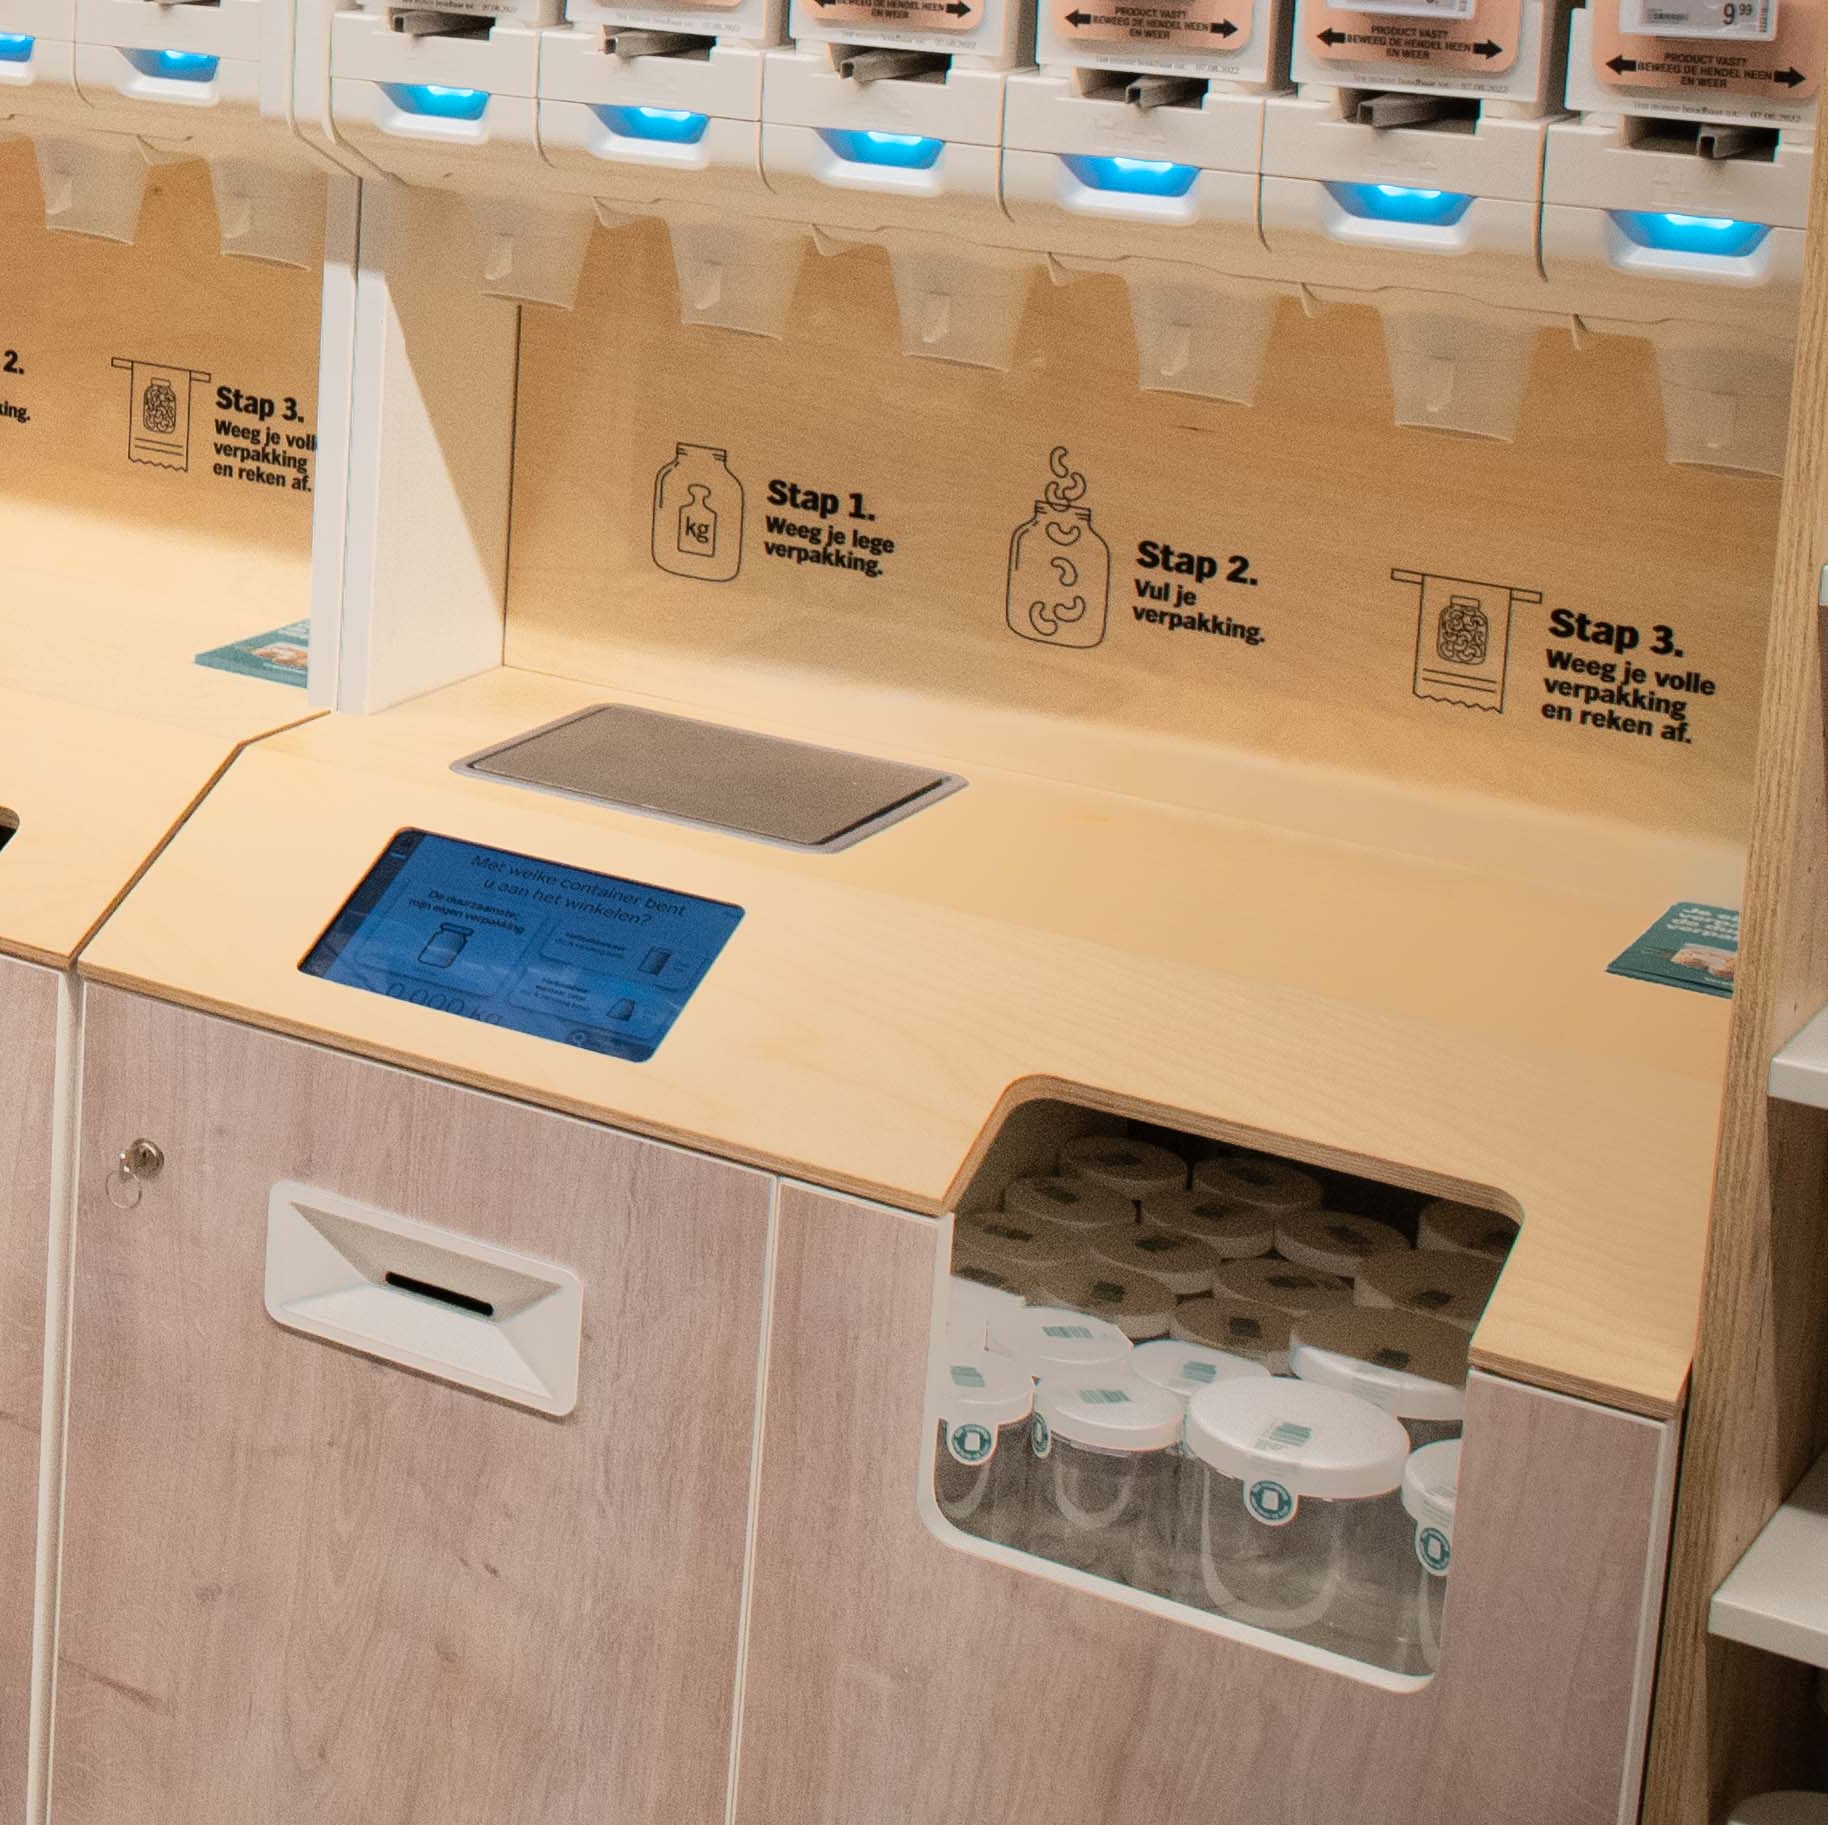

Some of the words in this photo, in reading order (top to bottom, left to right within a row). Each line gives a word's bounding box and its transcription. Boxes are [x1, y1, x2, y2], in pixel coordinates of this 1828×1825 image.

[3, 350, 24, 374] 2.
[216, 385, 274, 421] Stap
[282, 397, 304, 423] 3.
[215, 419, 261, 445] Weeg
[264, 427, 280, 447] je
[214, 442, 307, 474] verpakking
[213, 463, 233, 477] en
[238, 467, 286, 487] reken
[292, 476, 311, 492] af.
[767, 479, 839, 518] Stap
[849, 493, 876, 521] 1.
[685, 517, 709, 542] kg
[766, 515, 822, 544] Weeg
[828, 526, 845, 547] je
[853, 530, 894, 555] lege
[764, 541, 883, 578] verpakking.
[1136, 540, 1217, 583] Stap
[1226, 555, 1258, 586] 2.
[1134, 578, 1170, 601] Vul
[1174, 584, 1197, 607] je
[1132, 606, 1265, 645] verpakking.
[1548, 608, 1639, 655] Stap
[1650, 625, 1684, 657] 3.
[1546, 648, 1617, 682] Weeg
[1621, 661, 1646, 686] je
[1655, 671, 1716, 695] volle
[1544, 677, 1687, 721] verpakking
[1541, 703, 1572, 722] en
[1580, 709, 1652, 736] reken
[1661, 722, 1692, 744] af.
[471, 855, 506, 871] Met
[508, 864, 558, 885] welke
[560, 875, 642, 905] container
[646, 896, 687, 917] bent
[534, 888, 561, 904] het
[565, 897, 652, 926] winkelen?
